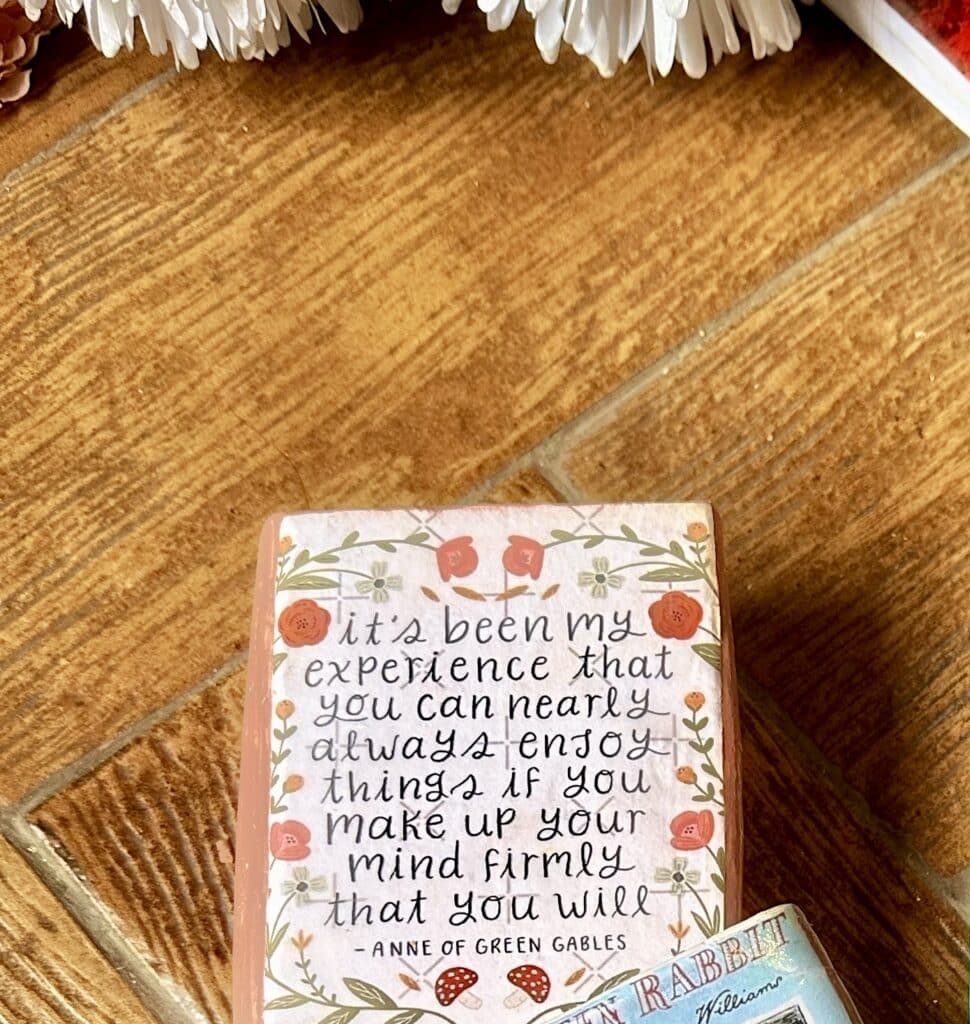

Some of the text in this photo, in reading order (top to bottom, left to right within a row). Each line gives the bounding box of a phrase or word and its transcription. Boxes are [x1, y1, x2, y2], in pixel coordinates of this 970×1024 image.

[337, 605, 647, 645] it's been my
[304, 644, 674, 688] experience that
[313, 687, 671, 727] you can nearly
[310, 728, 671, 762] always enjoy
[320, 764, 652, 804] things if you
[325, 805, 647, 845] make up your
[347, 840, 636, 883] mind firmly
[323, 885, 653, 928] that you will
[441, 939, 466, 954] OF
[474, 936, 543, 954] GREEN
[552, 934, 628, 952] GABLES
[630, 912, 793, 1017] RABBIT
